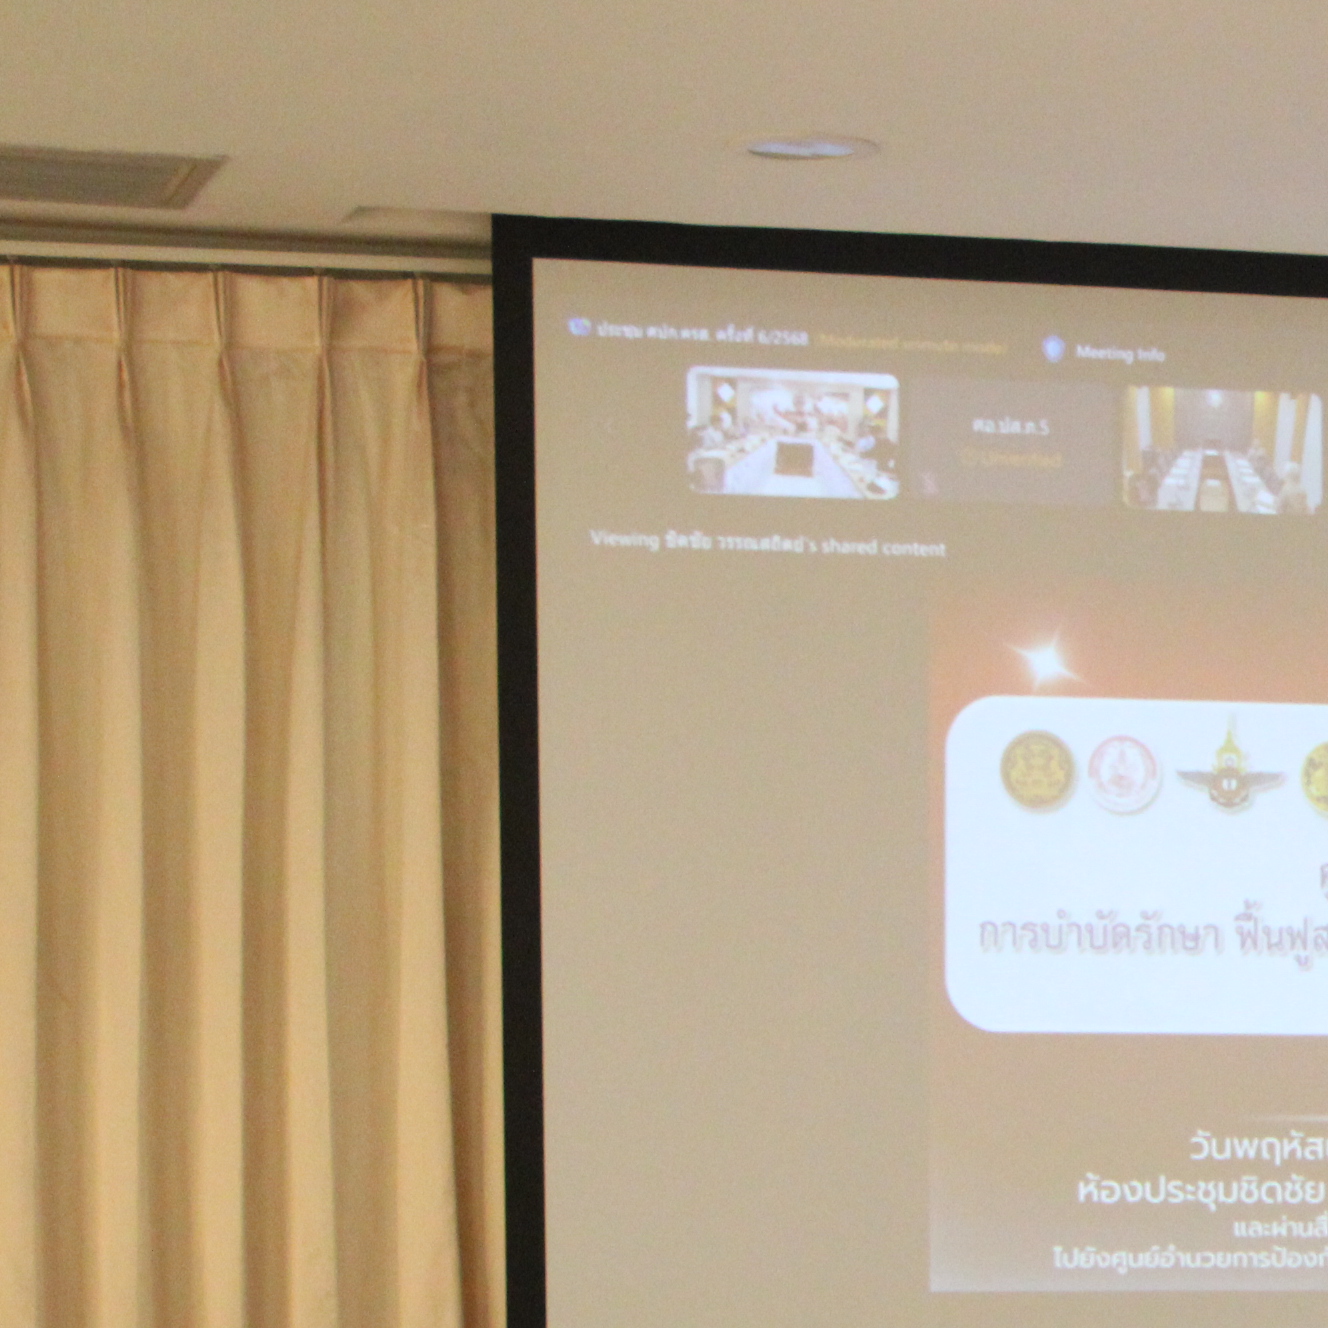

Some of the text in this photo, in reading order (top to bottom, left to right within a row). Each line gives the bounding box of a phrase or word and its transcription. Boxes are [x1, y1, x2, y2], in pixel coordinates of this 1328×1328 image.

[757, 329, 809, 345] 6/2568
[1076, 344, 1166, 364] Meeting Info
[590, 530, 660, 554] Viewing
[823, 537, 879, 556] shared
[883, 541, 947, 558] content
[979, 908, 1221, 955] การบำบัดรักษา
[1077, 1173, 1325, 1212] ห้องประชุมชิดชัย
